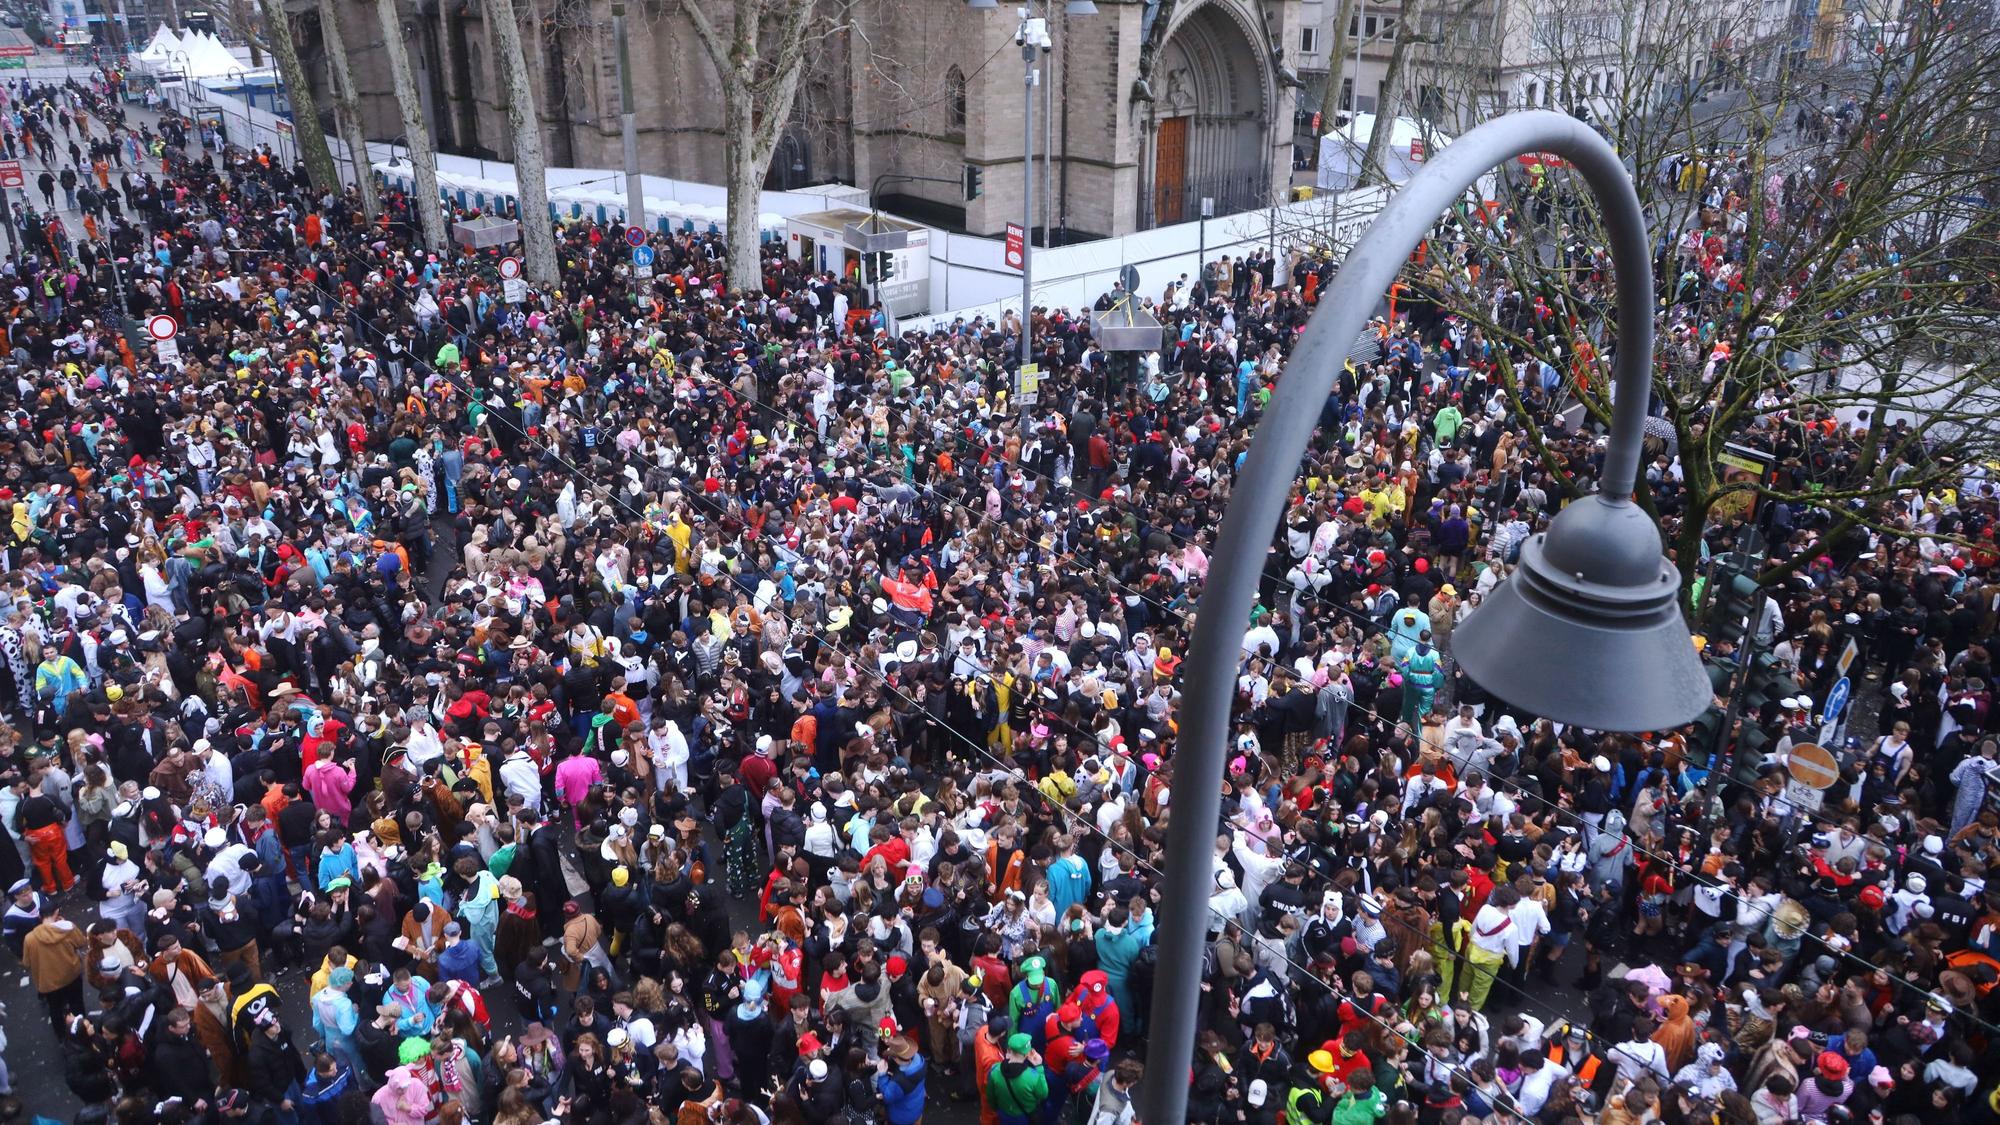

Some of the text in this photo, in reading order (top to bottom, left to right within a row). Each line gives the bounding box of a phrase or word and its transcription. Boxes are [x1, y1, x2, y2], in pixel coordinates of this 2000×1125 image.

[1008, 225, 1024, 239] REWE
[1942, 912, 1967, 925] FBI
[515, 980, 532, 1000] POLICE
